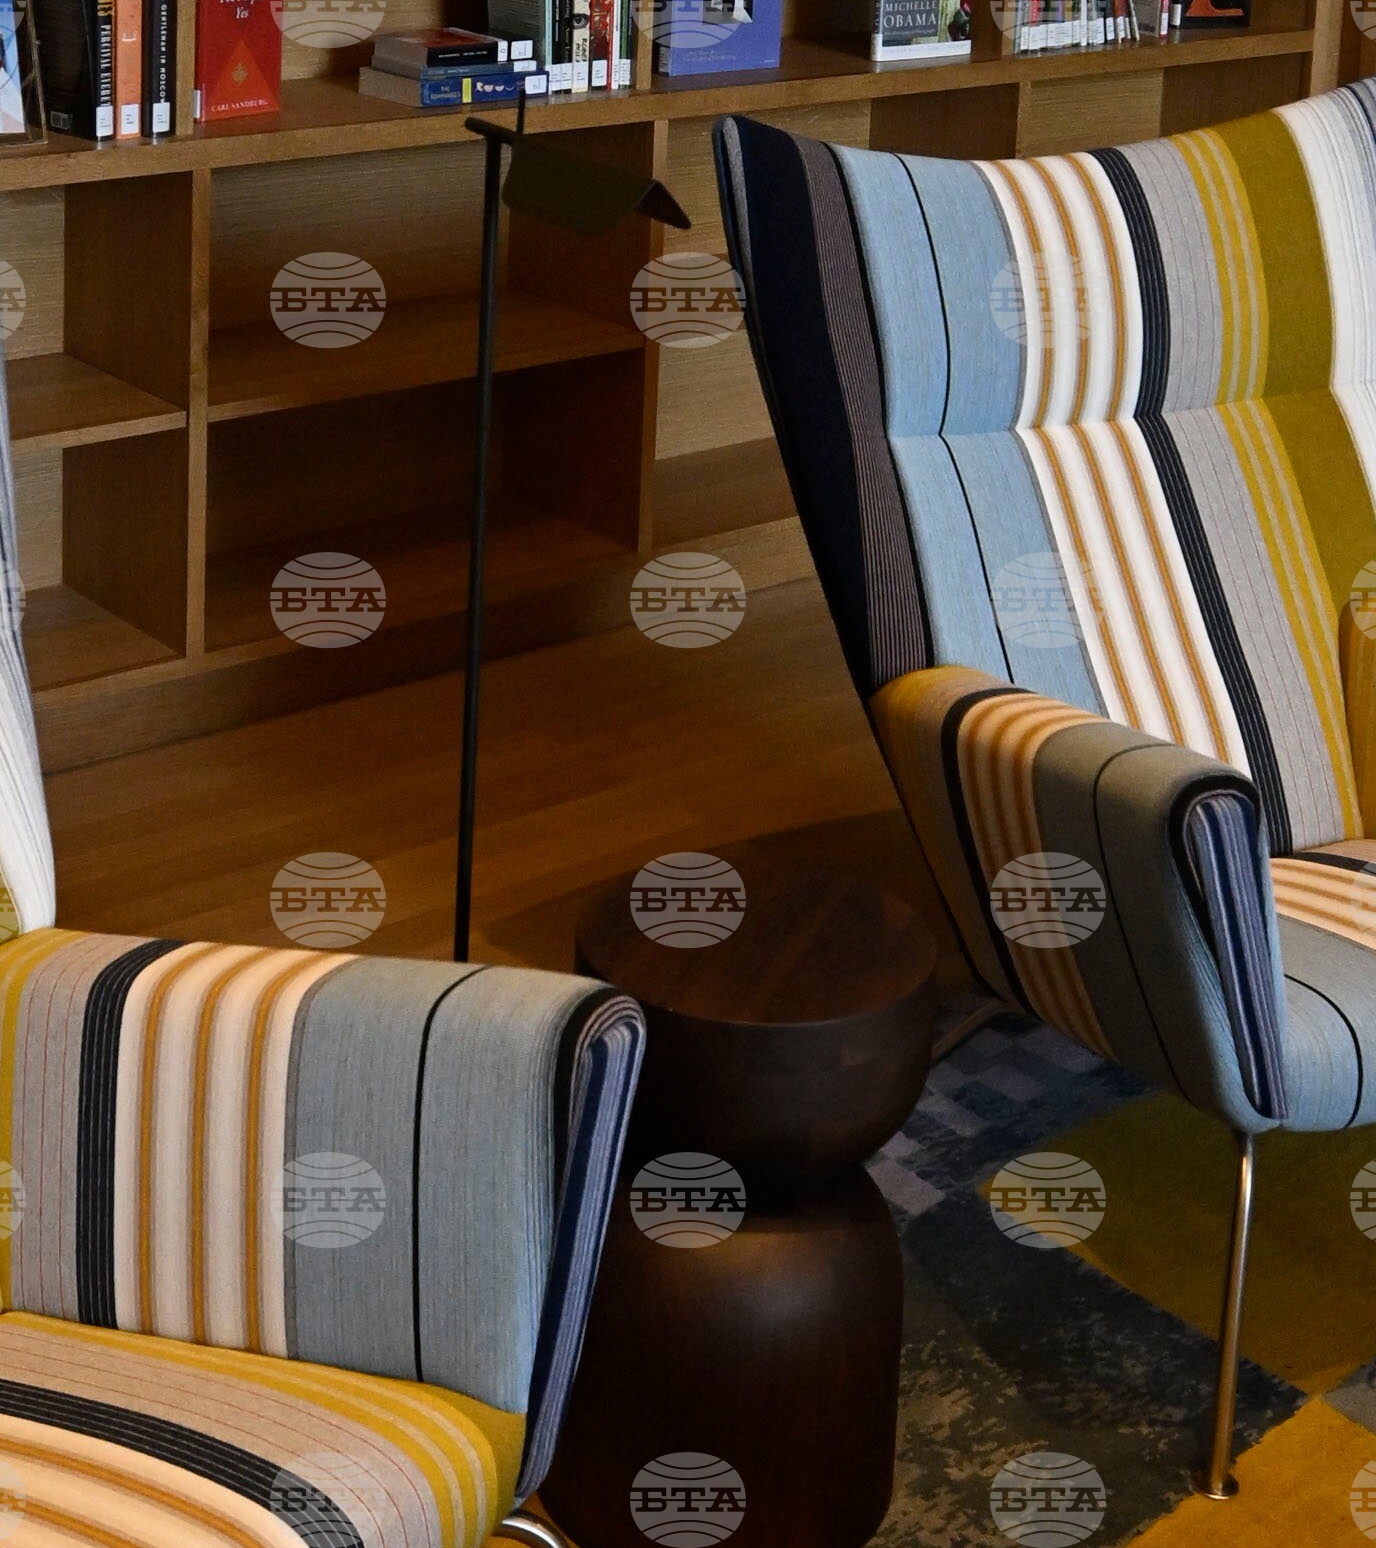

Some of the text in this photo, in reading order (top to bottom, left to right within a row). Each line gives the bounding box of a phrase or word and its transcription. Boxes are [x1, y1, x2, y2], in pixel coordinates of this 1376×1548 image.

[885, 0, 937, 12] MICHELLE
[235, 7, 249, 19] Yes
[884, 13, 936, 28] OBAMA
